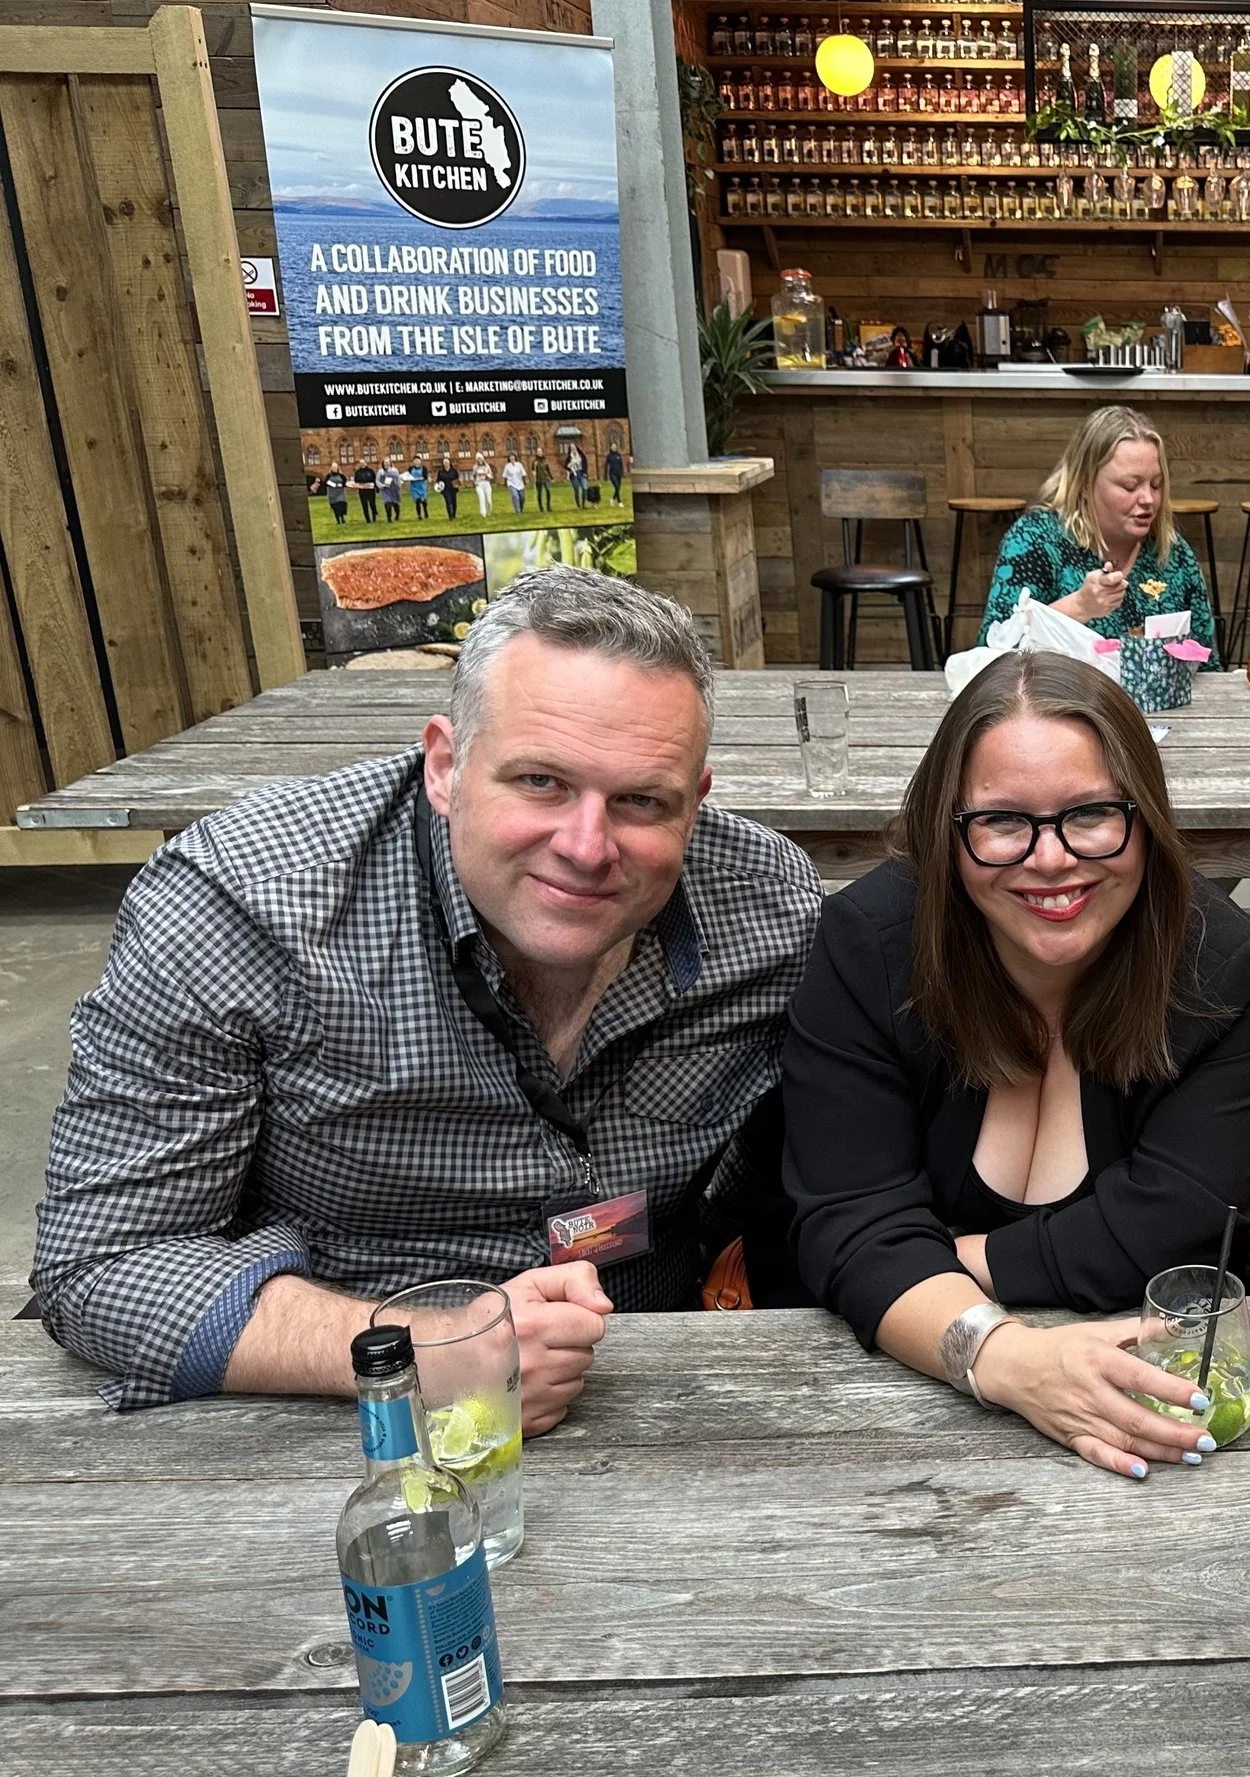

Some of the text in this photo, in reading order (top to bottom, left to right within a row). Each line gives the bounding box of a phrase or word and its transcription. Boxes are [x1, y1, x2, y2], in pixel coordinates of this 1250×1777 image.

[391, 115, 483, 159] BUTE
[395, 163, 487, 191] KITCHEN
[311, 243, 597, 277] A COLLABORATION OF FOOD
[247, 301, 267, 310] oking
[316, 284, 599, 316] AND DRINK BUSINESSES
[319, 325, 601, 356] FROM THE ISLE OF BUTE
[324, 382, 447, 396] WWW.BUTEKITCHEN.CO.UK
[465, 379, 604, 393] MARKETING@BUTEKITCHEN.CO.UK
[345, 404, 407, 417] BUTEKITCHEN
[449, 401, 507, 414] BUTEKITCHEN
[551, 399, 606, 411] BUTEKITCHEN
[344, 1585, 389, 1622] ON
[349, 1612, 390, 1635] CORD
